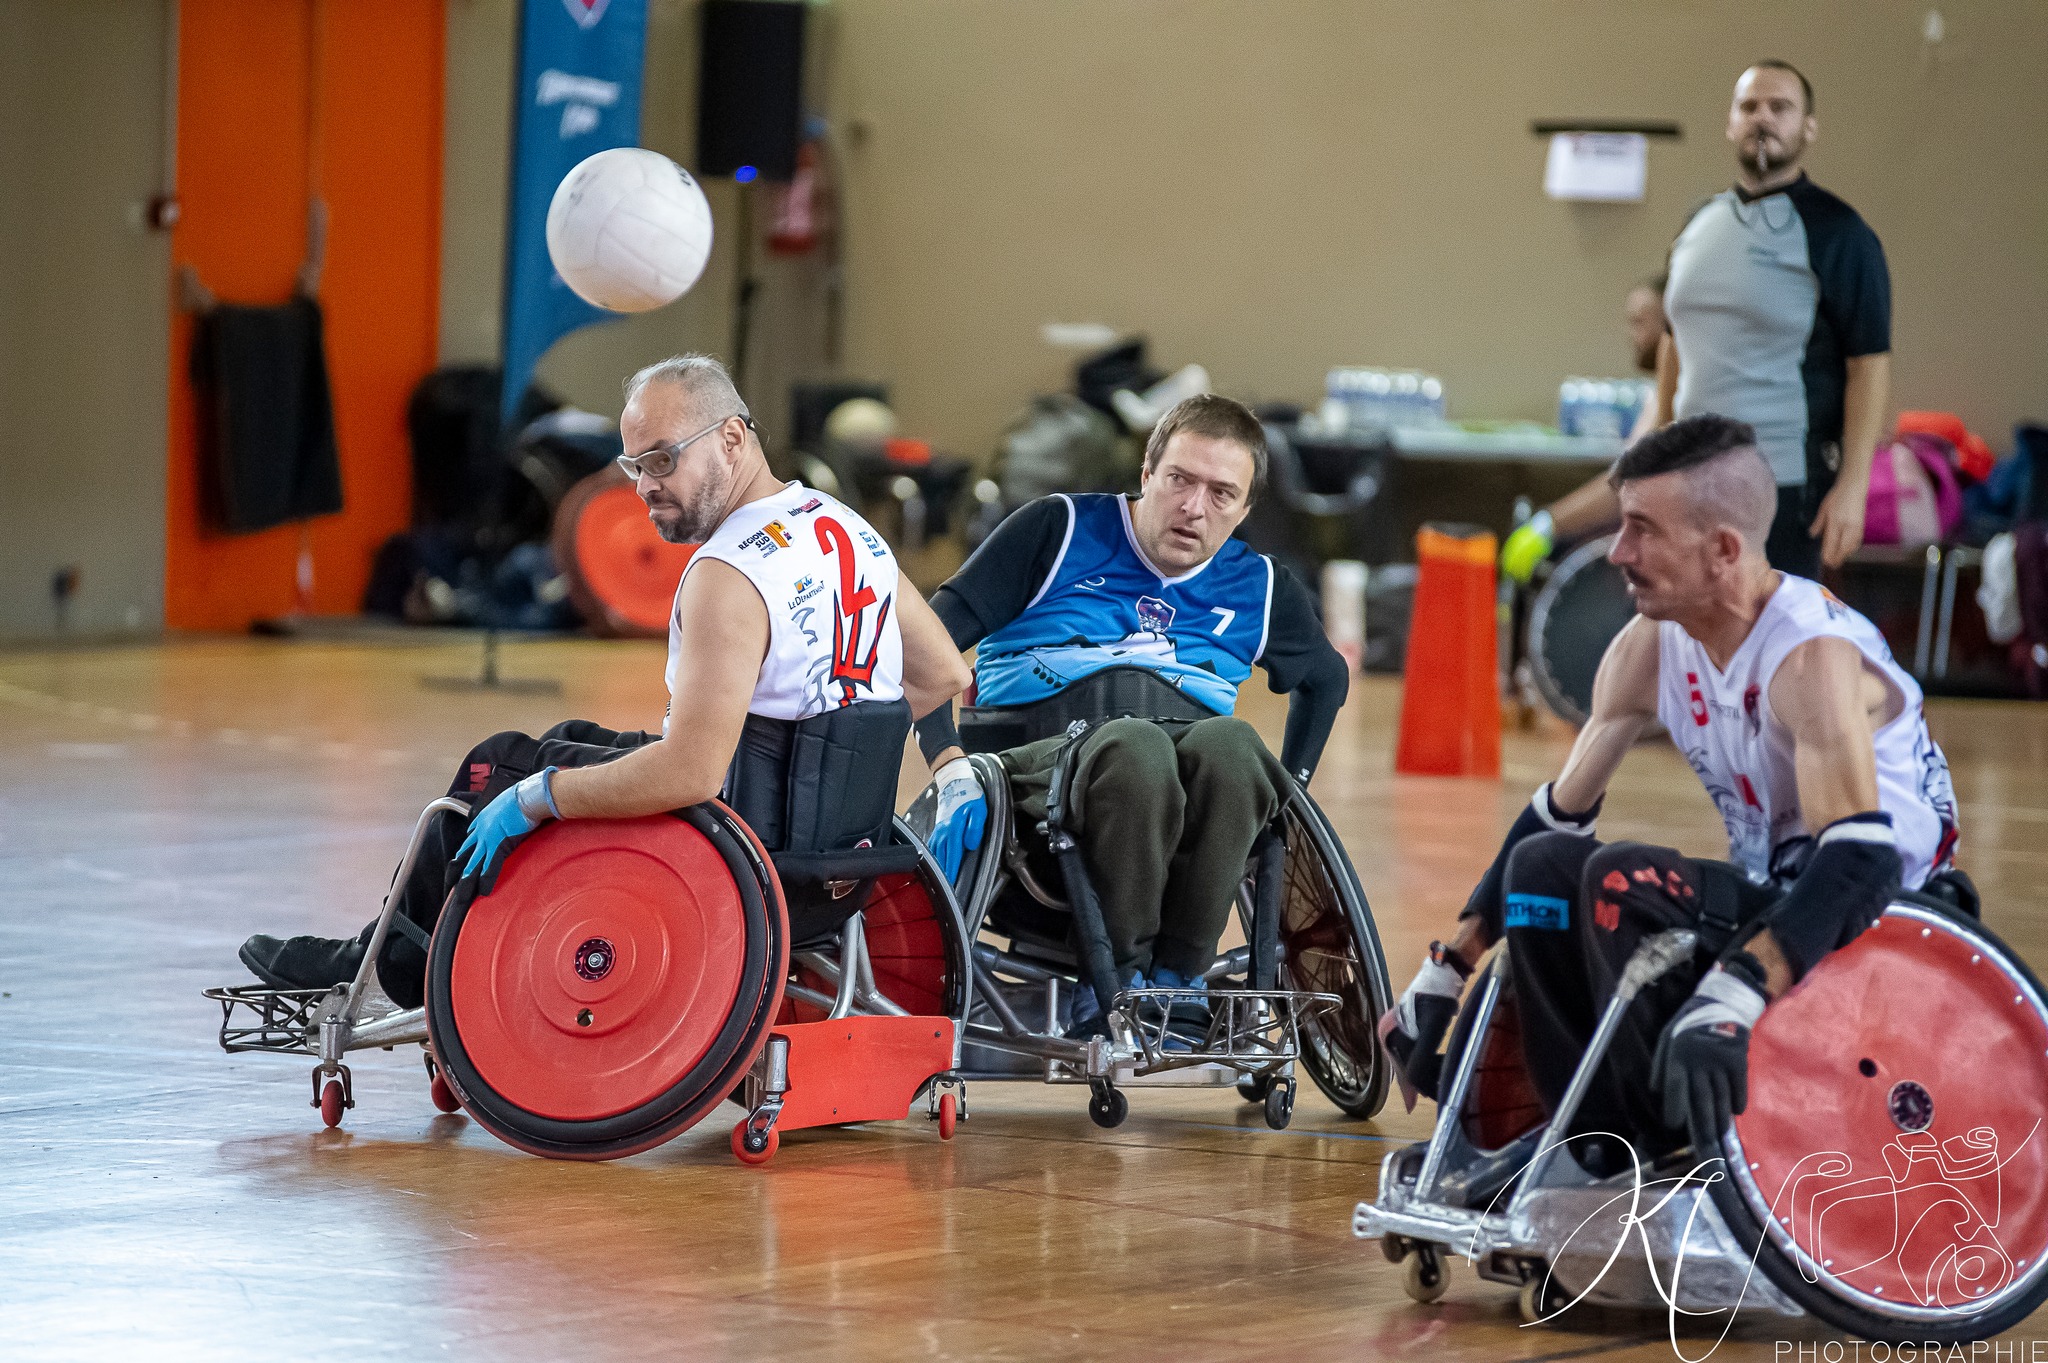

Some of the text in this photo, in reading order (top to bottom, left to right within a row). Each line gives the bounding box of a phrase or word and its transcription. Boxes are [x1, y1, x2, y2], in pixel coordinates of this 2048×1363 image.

[755, 535, 771, 548] SUD
[814, 515, 877, 618] 2
[1211, 606, 1236, 636] 7
